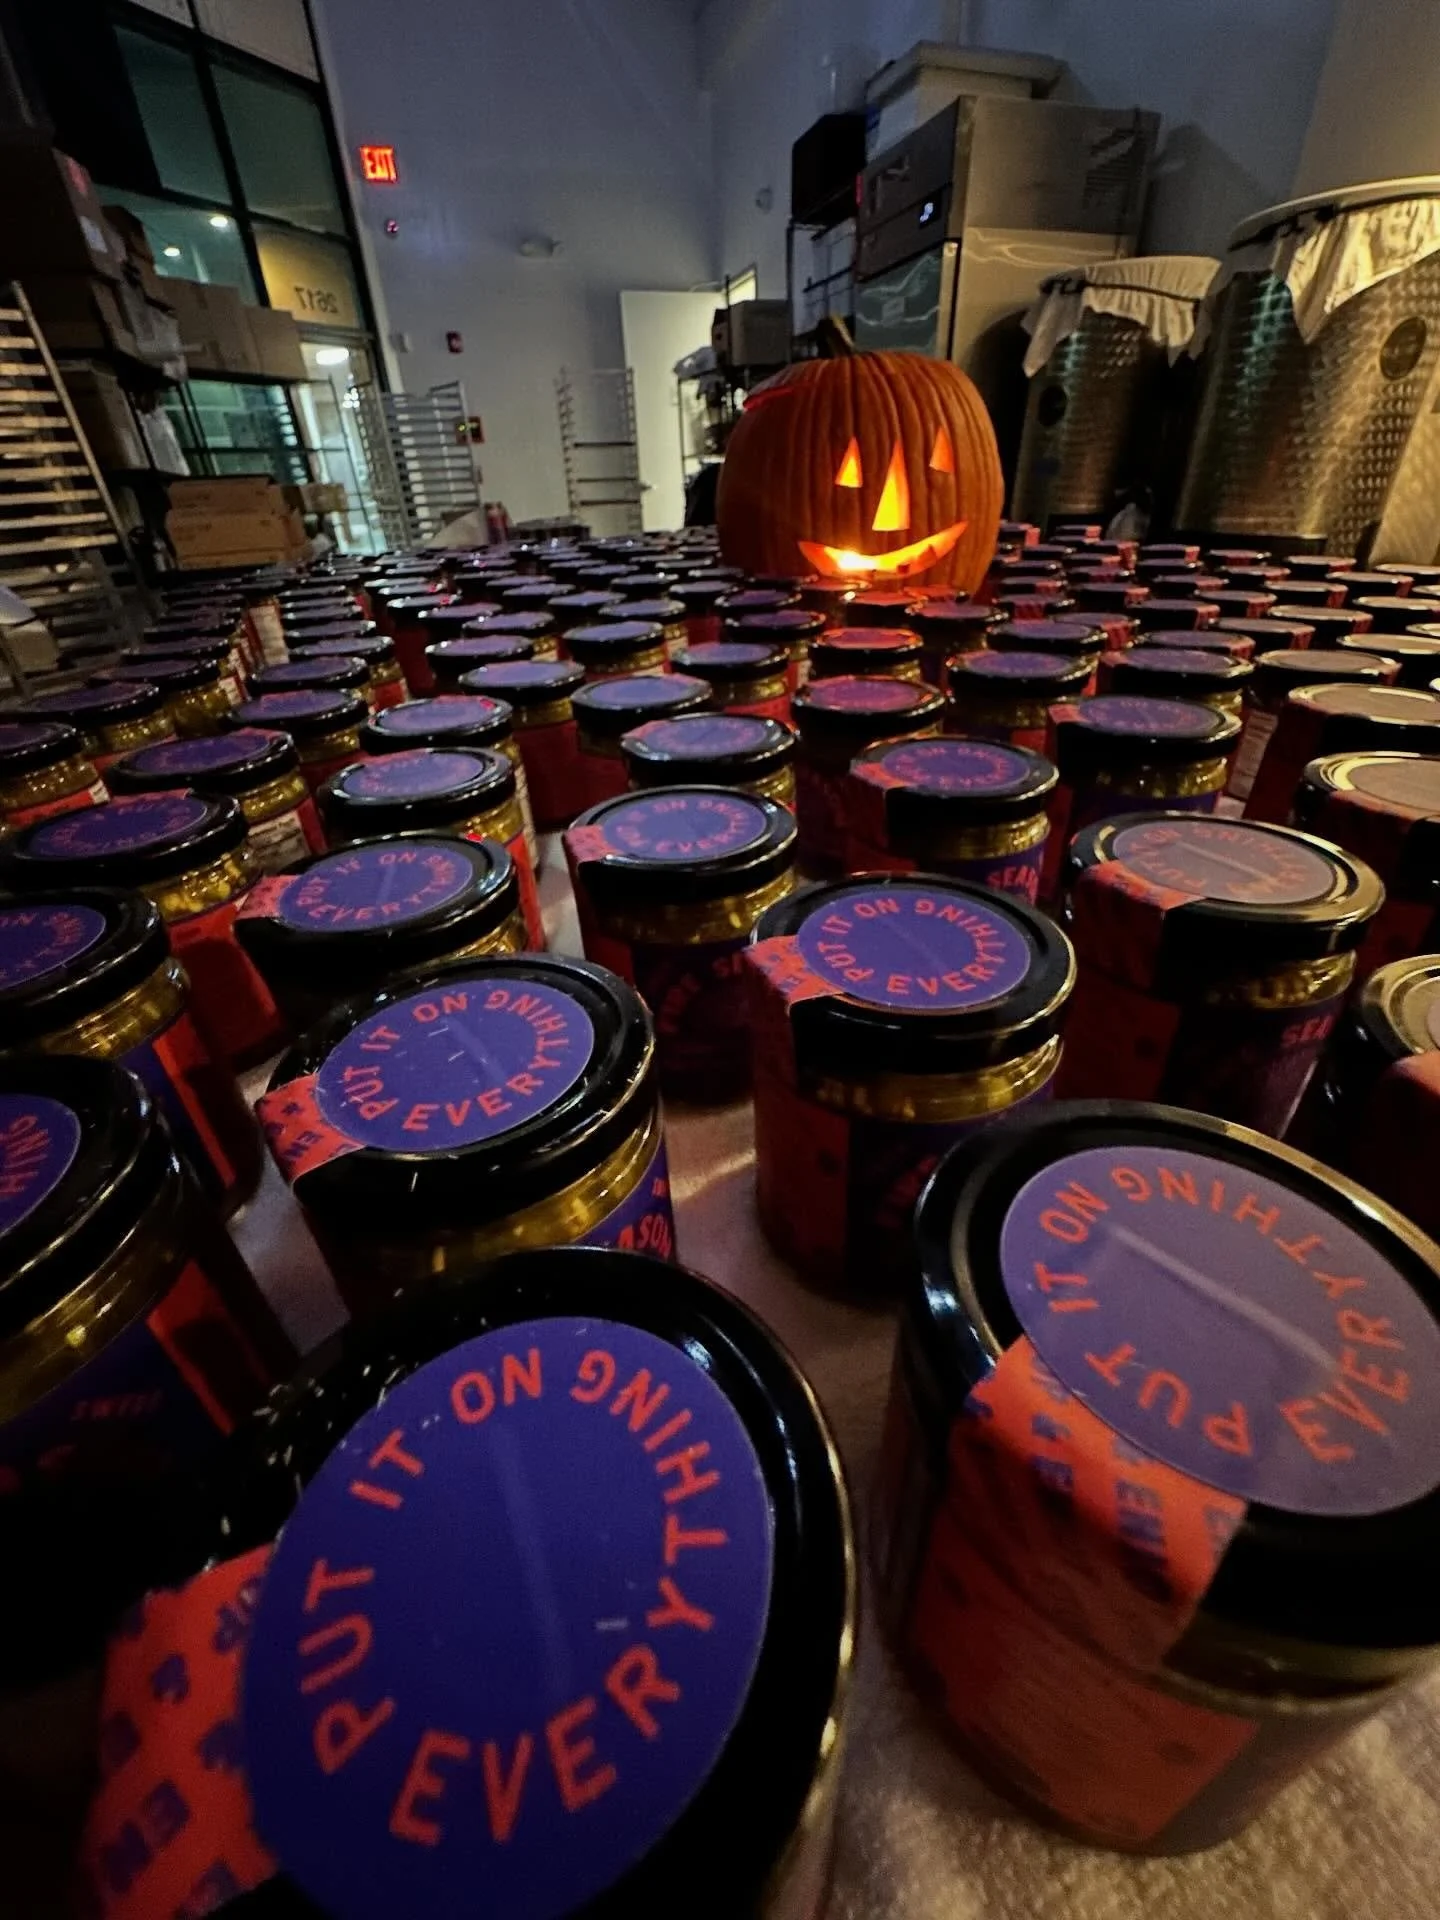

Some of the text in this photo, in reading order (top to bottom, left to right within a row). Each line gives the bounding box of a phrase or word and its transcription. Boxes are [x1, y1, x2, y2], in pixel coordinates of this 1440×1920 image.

[361, 147, 397, 181] EXIT
[817, 898, 1006, 996] PUT IT ON EVERYTHING
[343, 989, 570, 1132] PUT IT ON EVERYTHING
[1039, 1181, 1110, 1245] ON
[1035, 1261, 1098, 1313] IT
[1111, 1166, 1411, 1463] EVERYTHING
[1084, 1343, 1254, 1457] PUT
[300, 1347, 729, 1847] PUT IT ON EVERYTHING
